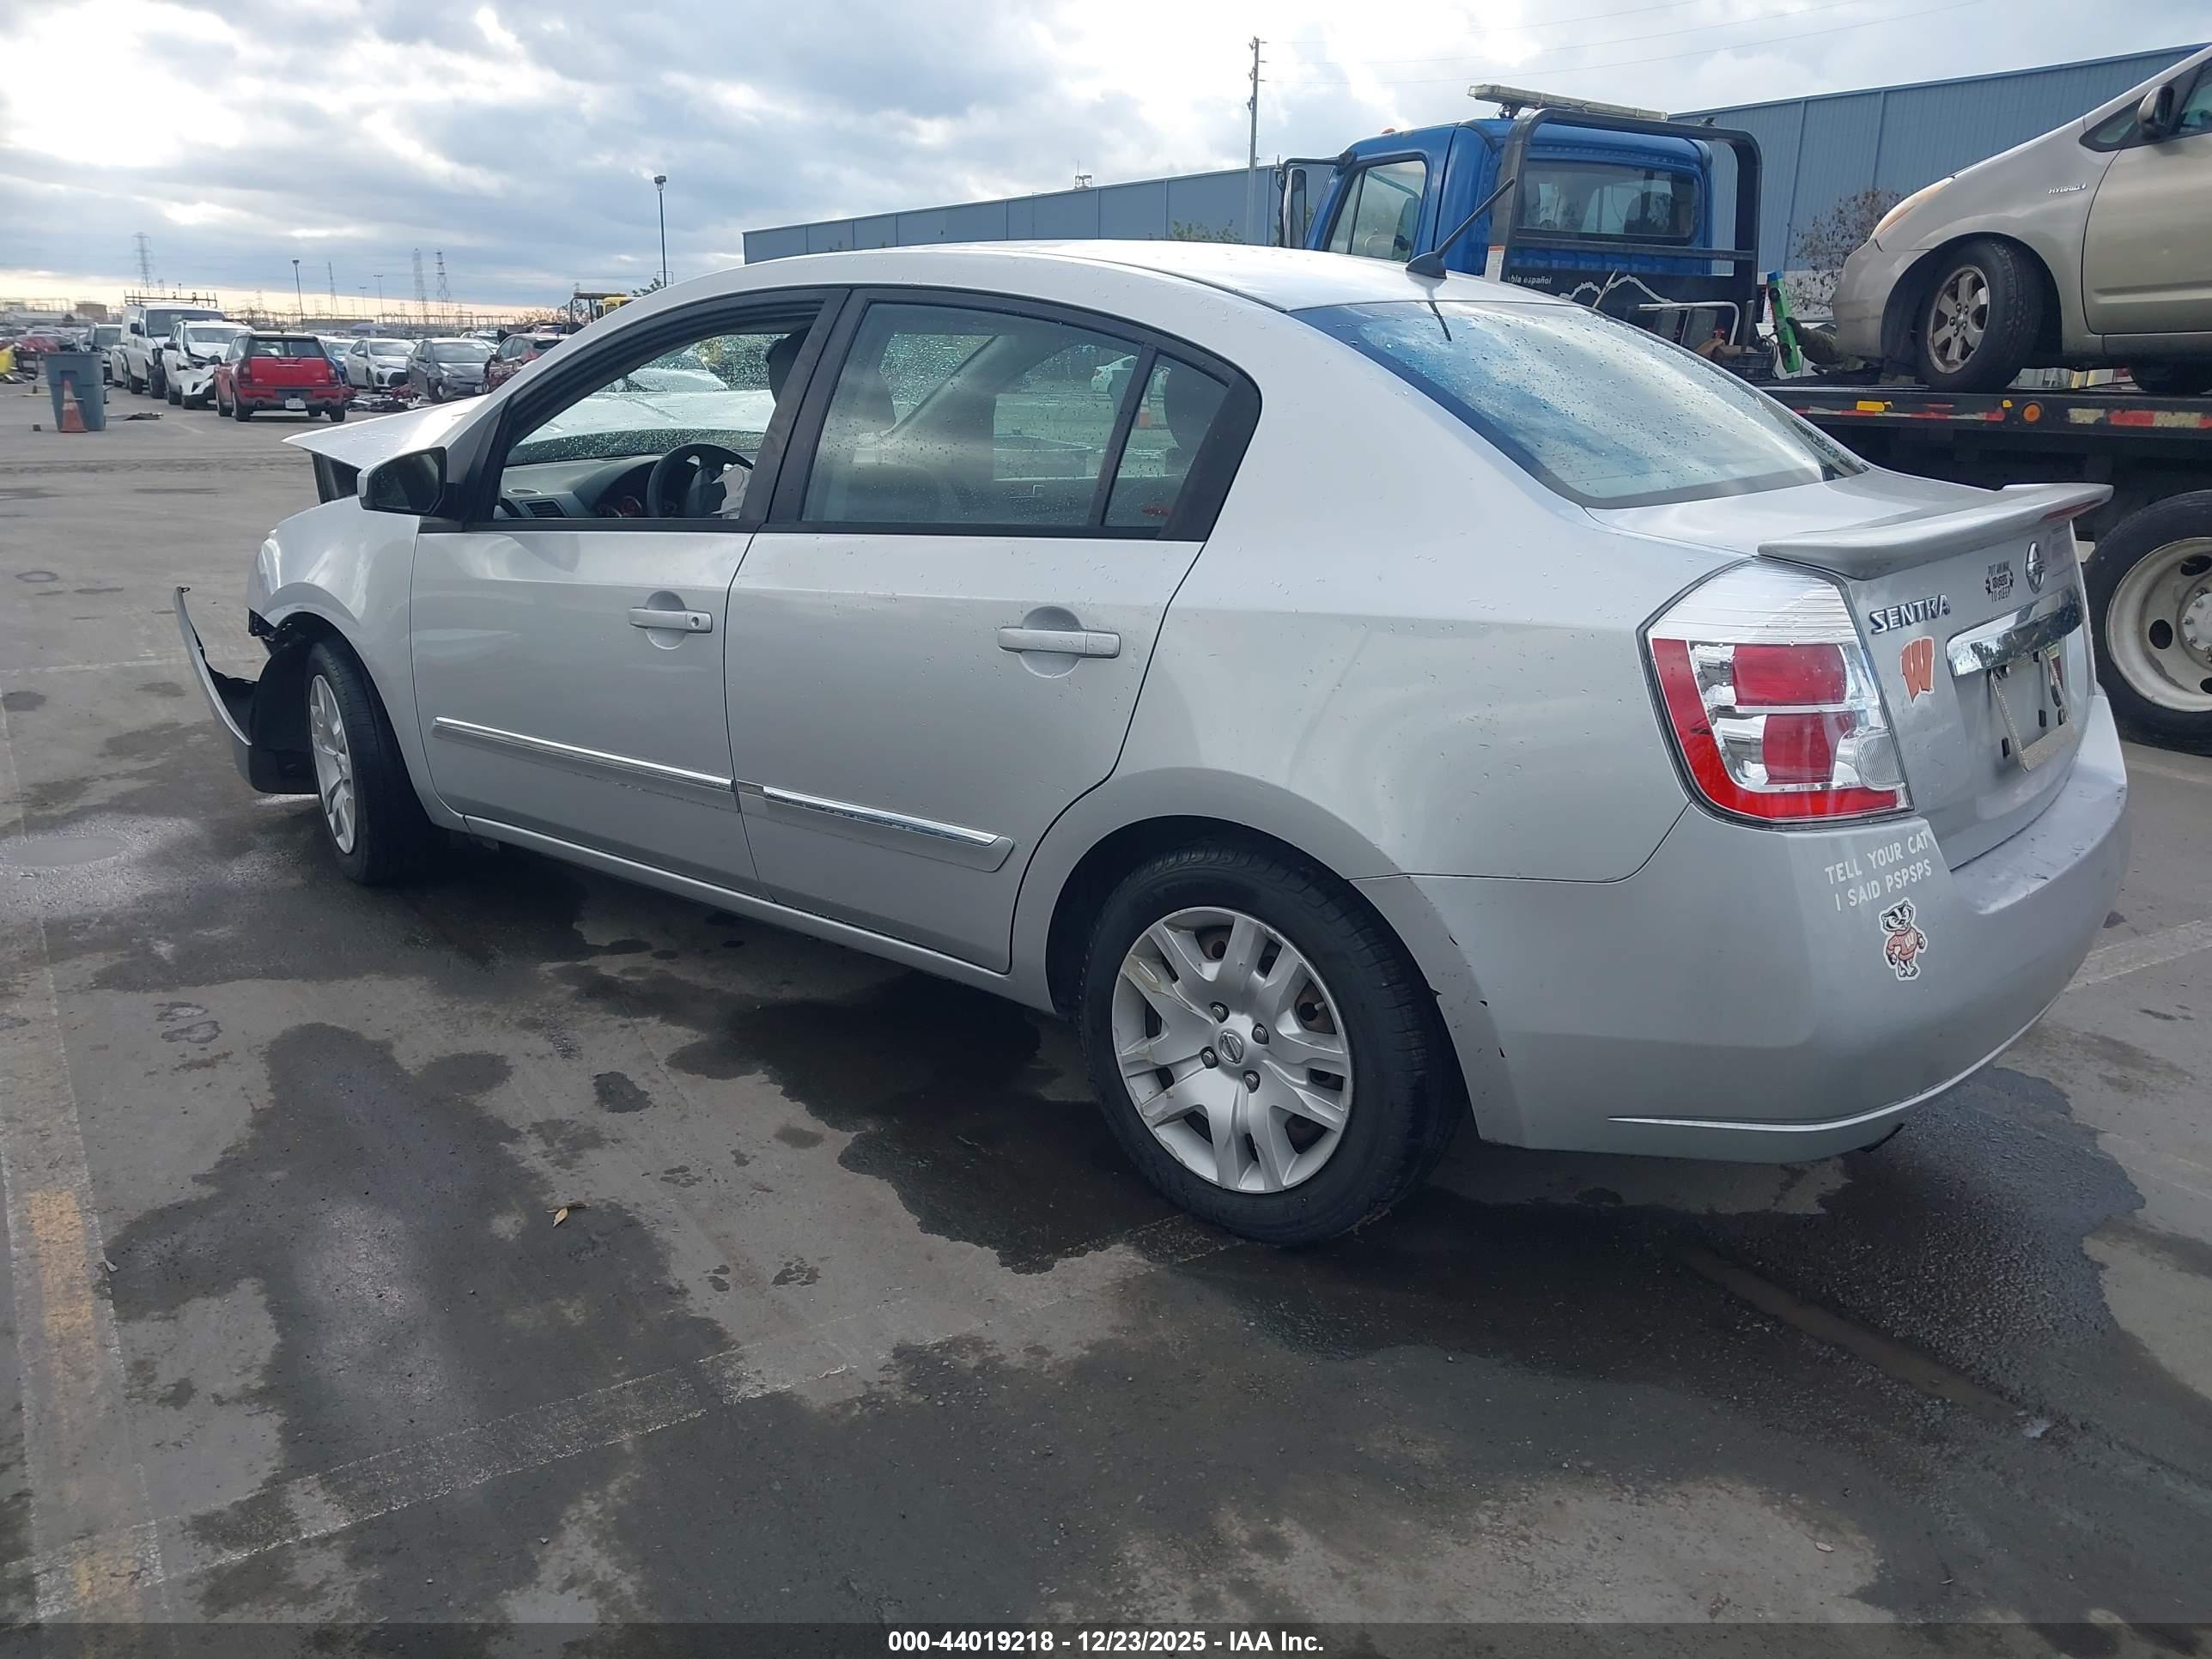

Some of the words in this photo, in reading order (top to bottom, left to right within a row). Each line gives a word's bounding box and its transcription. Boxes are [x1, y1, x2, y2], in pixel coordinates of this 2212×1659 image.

[1523, 275, 1553, 286] español
[1869, 593, 1950, 635] SENTRA
[1825, 859, 1863, 884] TELL
[1867, 842, 1904, 869] YOUR
[1907, 831, 1929, 854] CAT
[1834, 893, 1841, 911] I
[1847, 880, 1881, 907] SAID
[1886, 859, 1932, 893] PSPSPS
